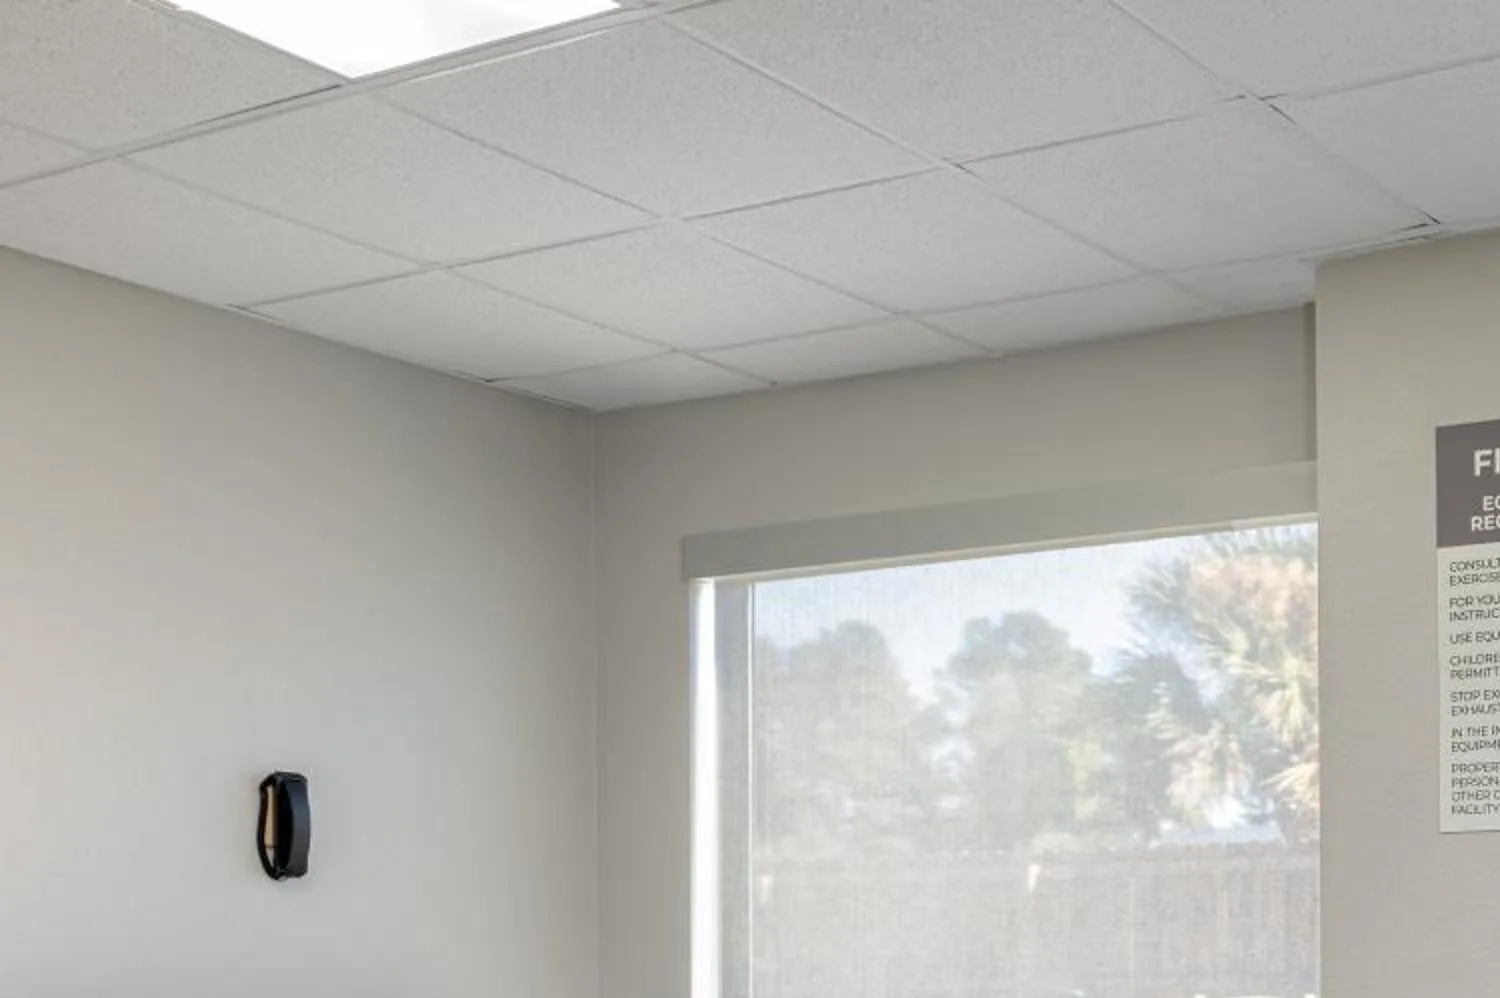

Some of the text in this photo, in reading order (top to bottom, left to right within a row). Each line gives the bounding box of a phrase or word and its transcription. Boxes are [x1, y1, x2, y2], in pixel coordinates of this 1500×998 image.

[1449, 557, 1500, 572] CONSULT
[1449, 595, 1473, 608] FOR
[1449, 632, 1472, 644] USE
[1450, 689, 1480, 702] STOP
[1451, 727, 1462, 738] IN
[1465, 725, 1487, 737] THE
[1451, 789, 1490, 802] OTHER
[1452, 803, 1500, 815] FACILITY
